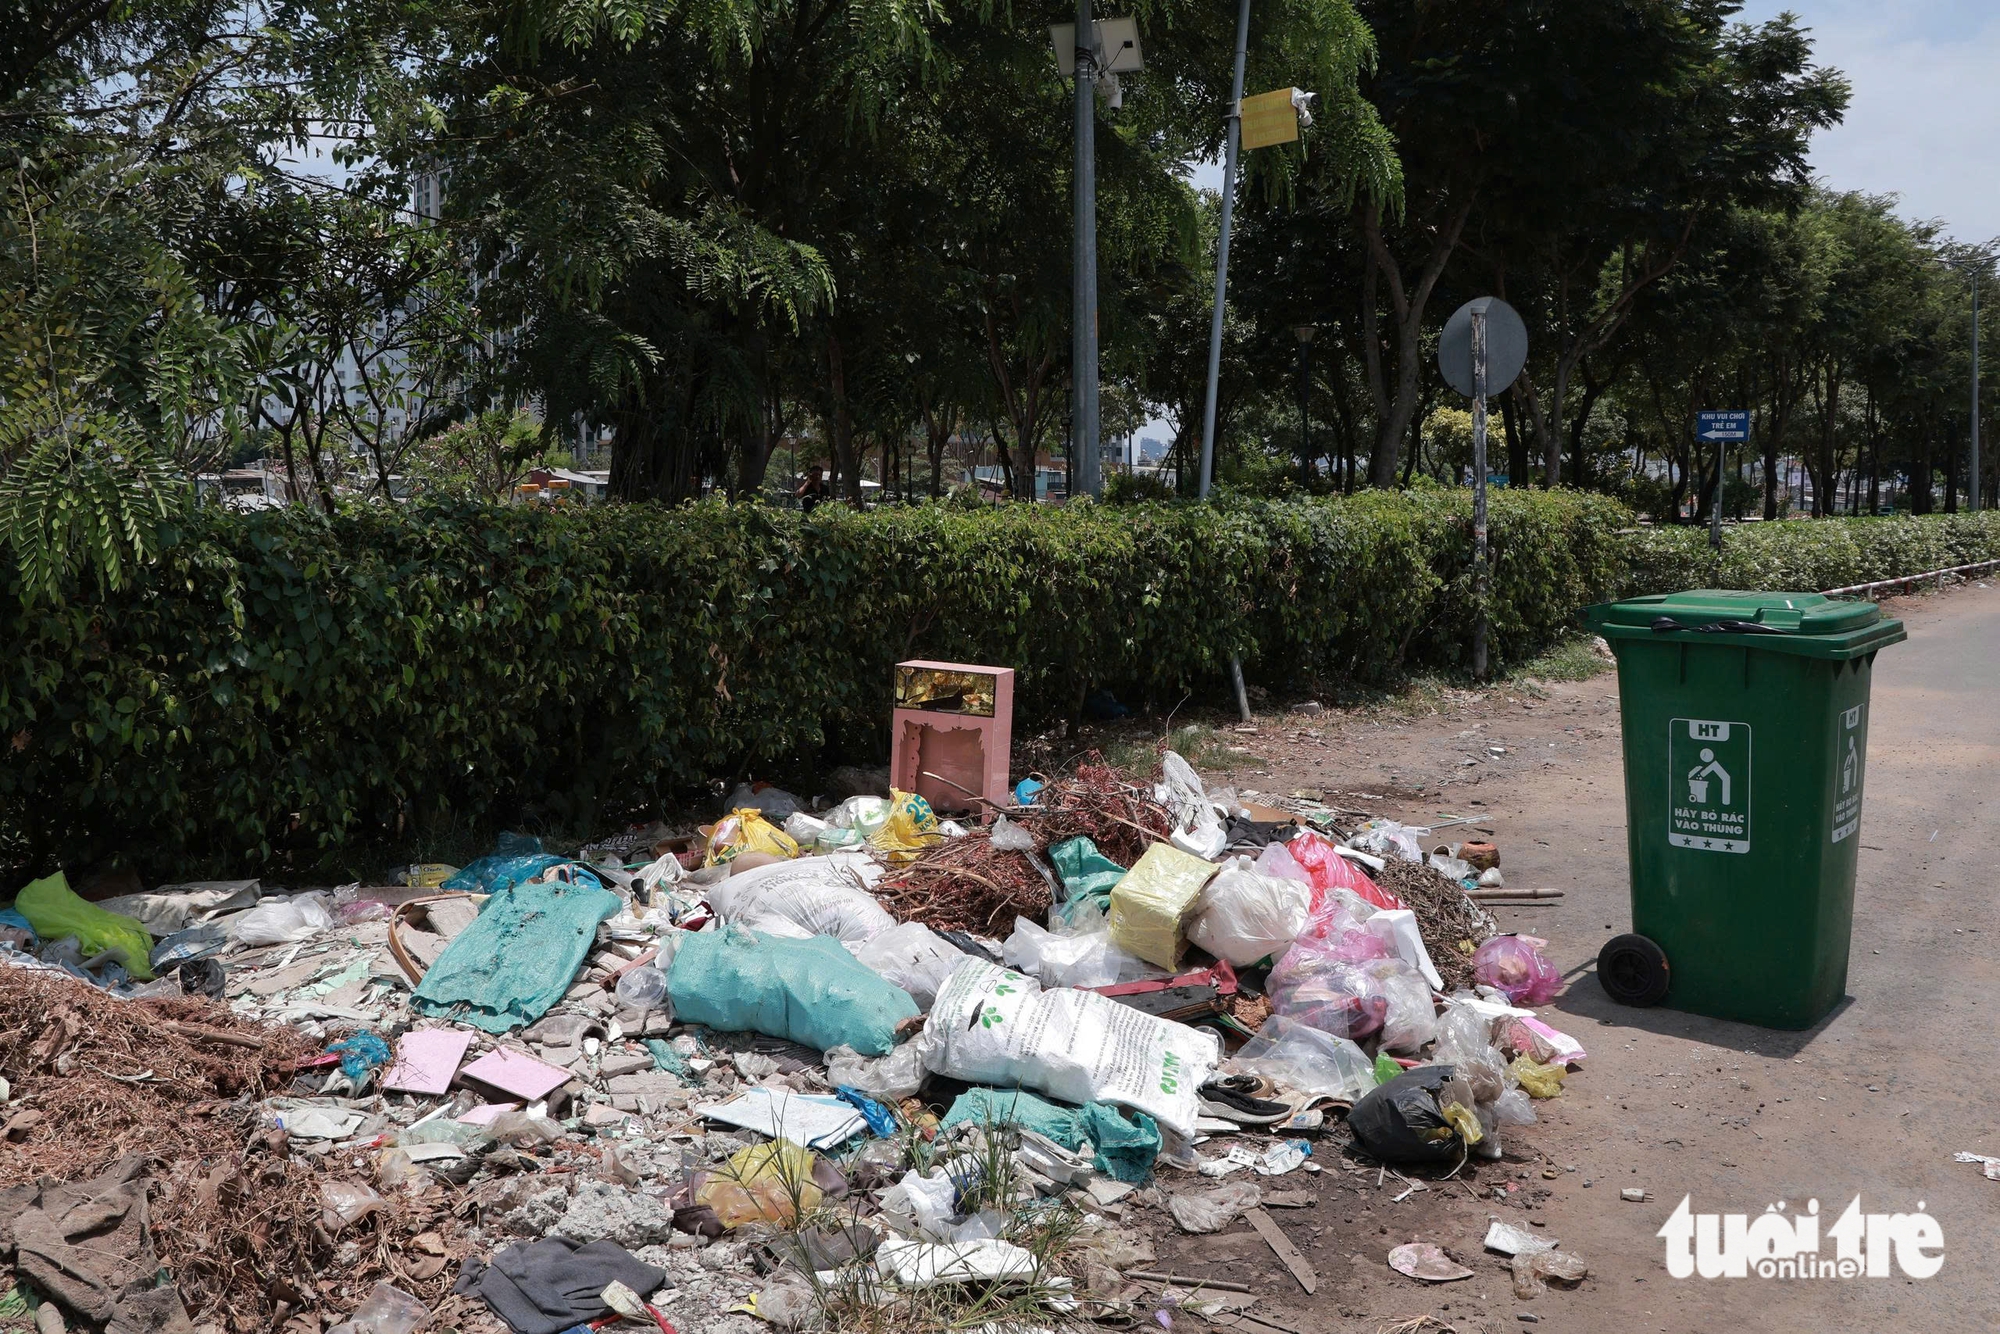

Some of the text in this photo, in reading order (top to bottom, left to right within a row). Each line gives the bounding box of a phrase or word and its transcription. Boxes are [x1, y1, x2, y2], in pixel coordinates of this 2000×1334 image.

[1711, 420, 1724, 429] TRẺ
[1698, 723, 1720, 738] HT
[1674, 807, 1745, 823] HÃY BỎ RÁC
[1675, 818, 1744, 835] VÀO THÙNG
